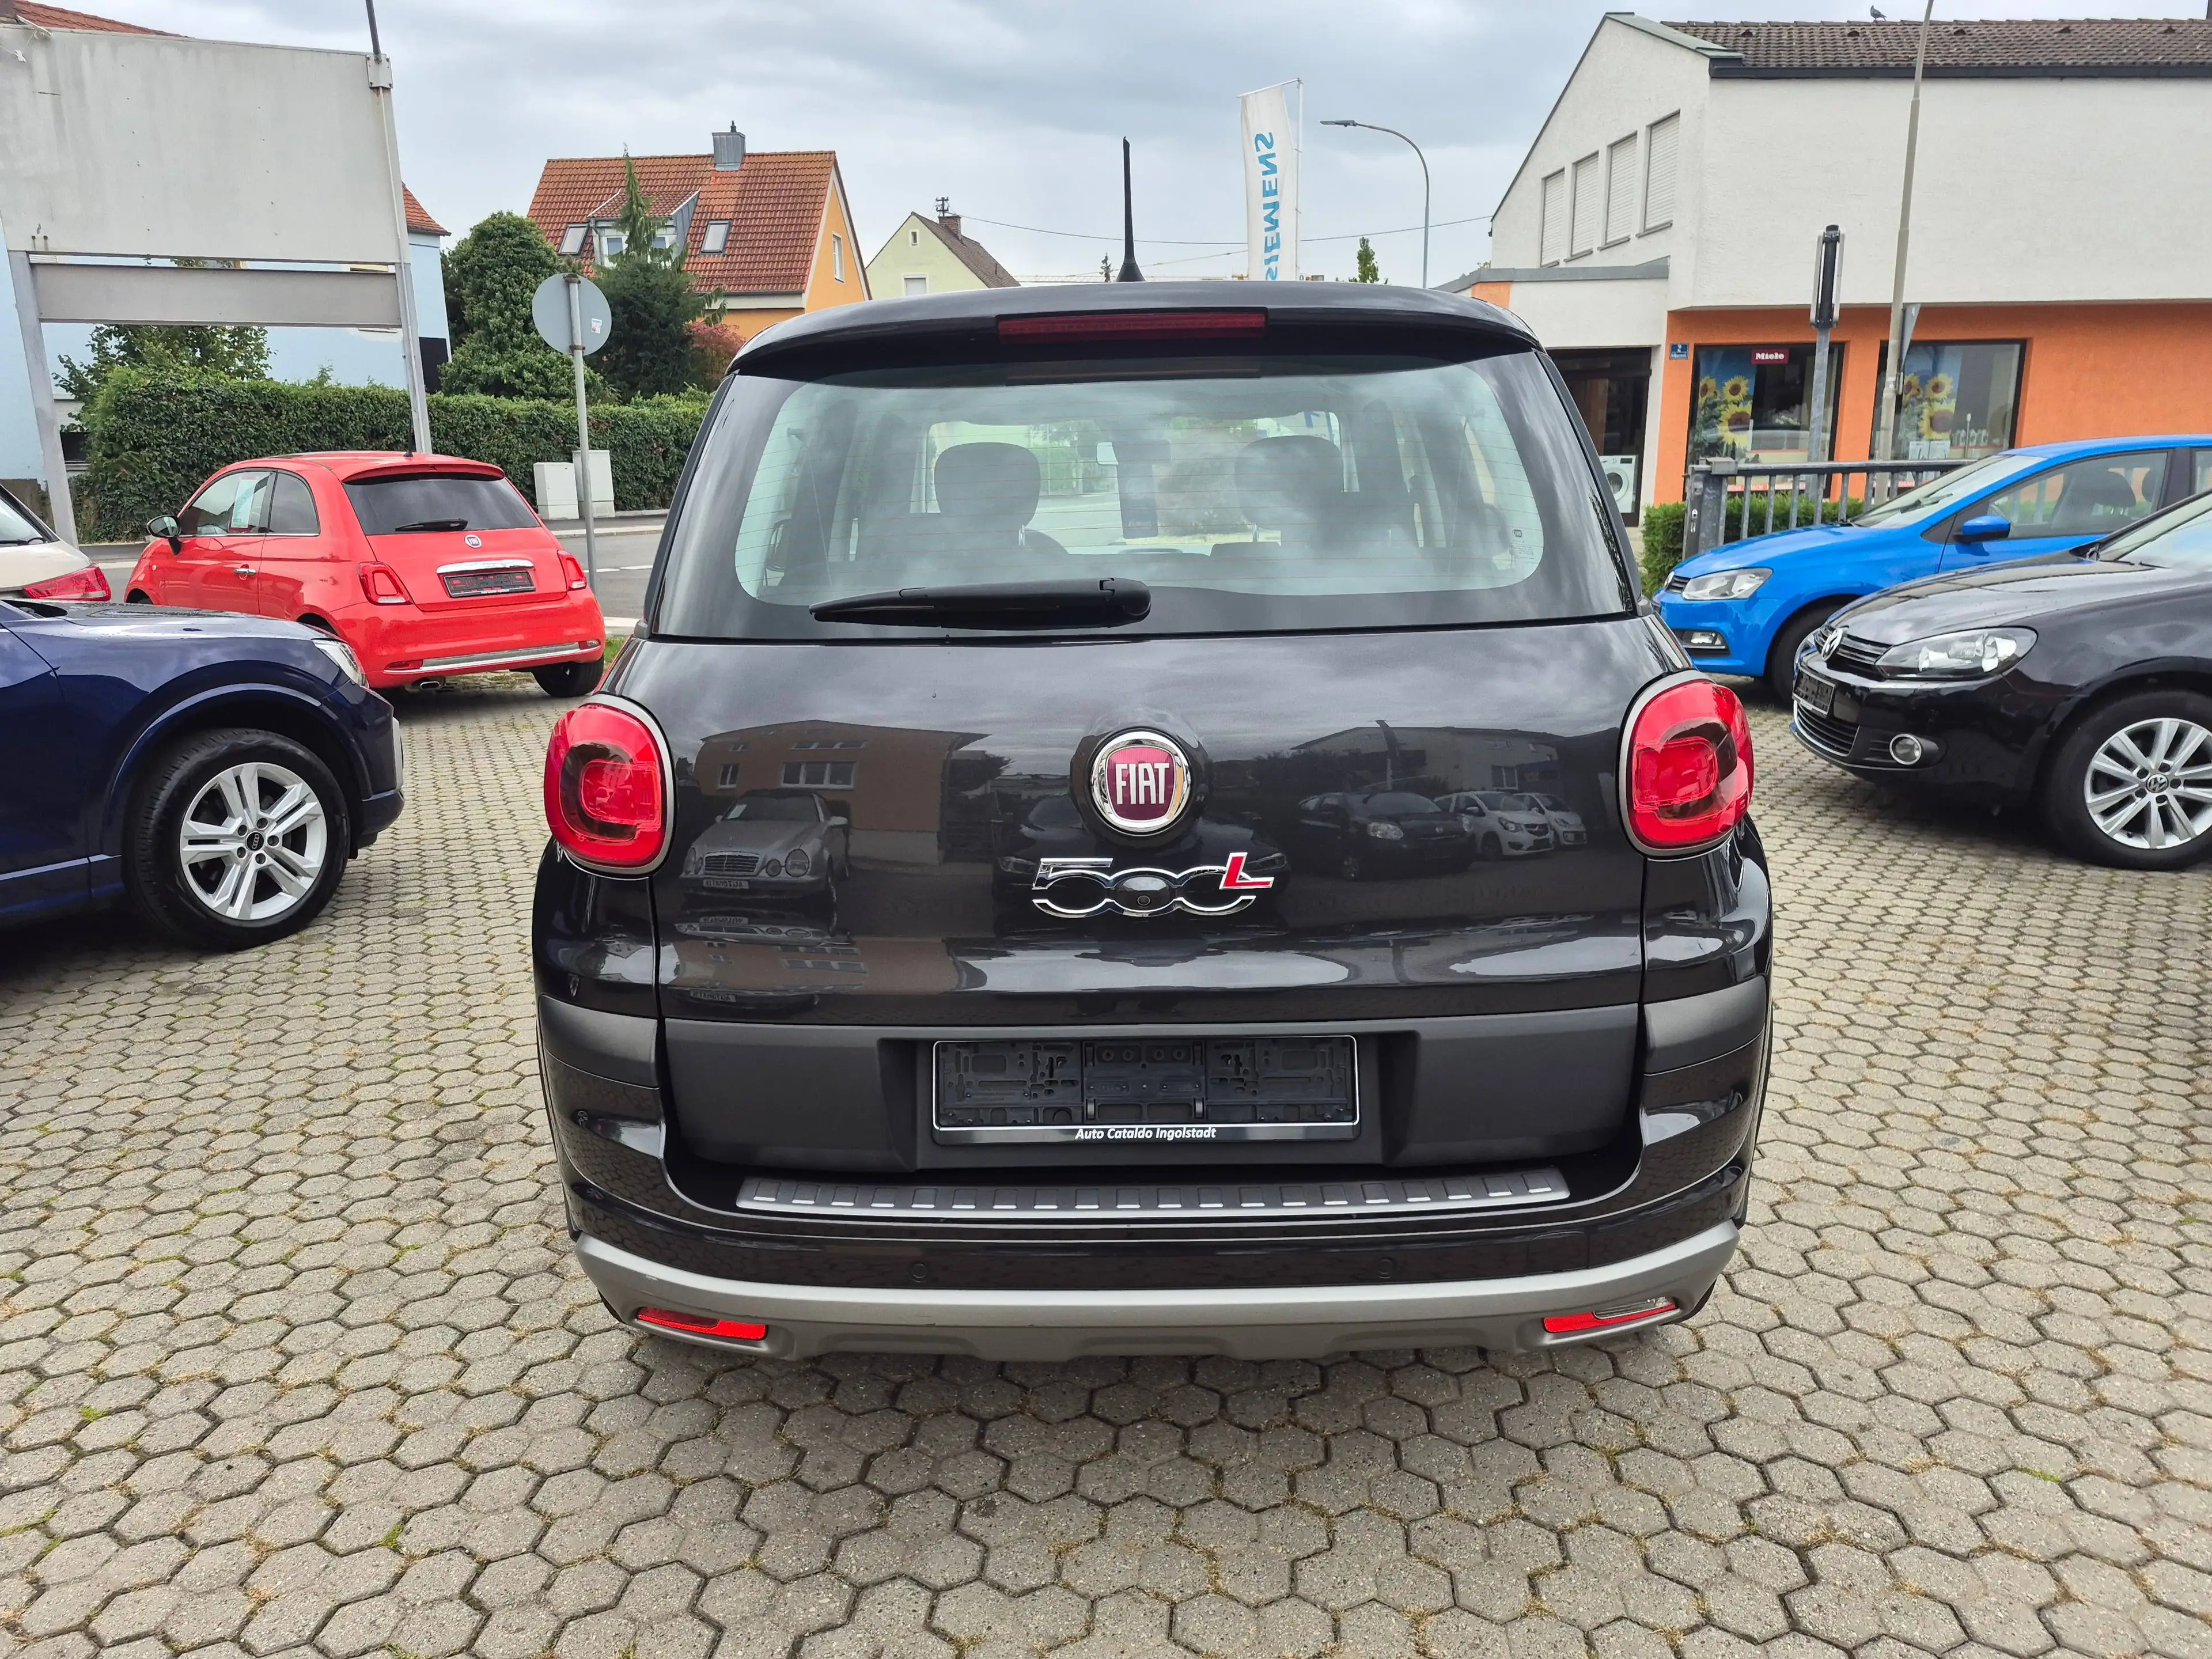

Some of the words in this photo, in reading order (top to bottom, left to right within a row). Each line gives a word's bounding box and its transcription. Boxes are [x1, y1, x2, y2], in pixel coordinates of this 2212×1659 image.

[1755, 352, 1785, 360] Miele
[1115, 763, 1170, 805] FIAT
[1075, 1128, 1104, 1139] Auto
[1107, 1127, 1153, 1139] Cataldo
[1156, 1127, 1217, 1141] Ingolstadt
